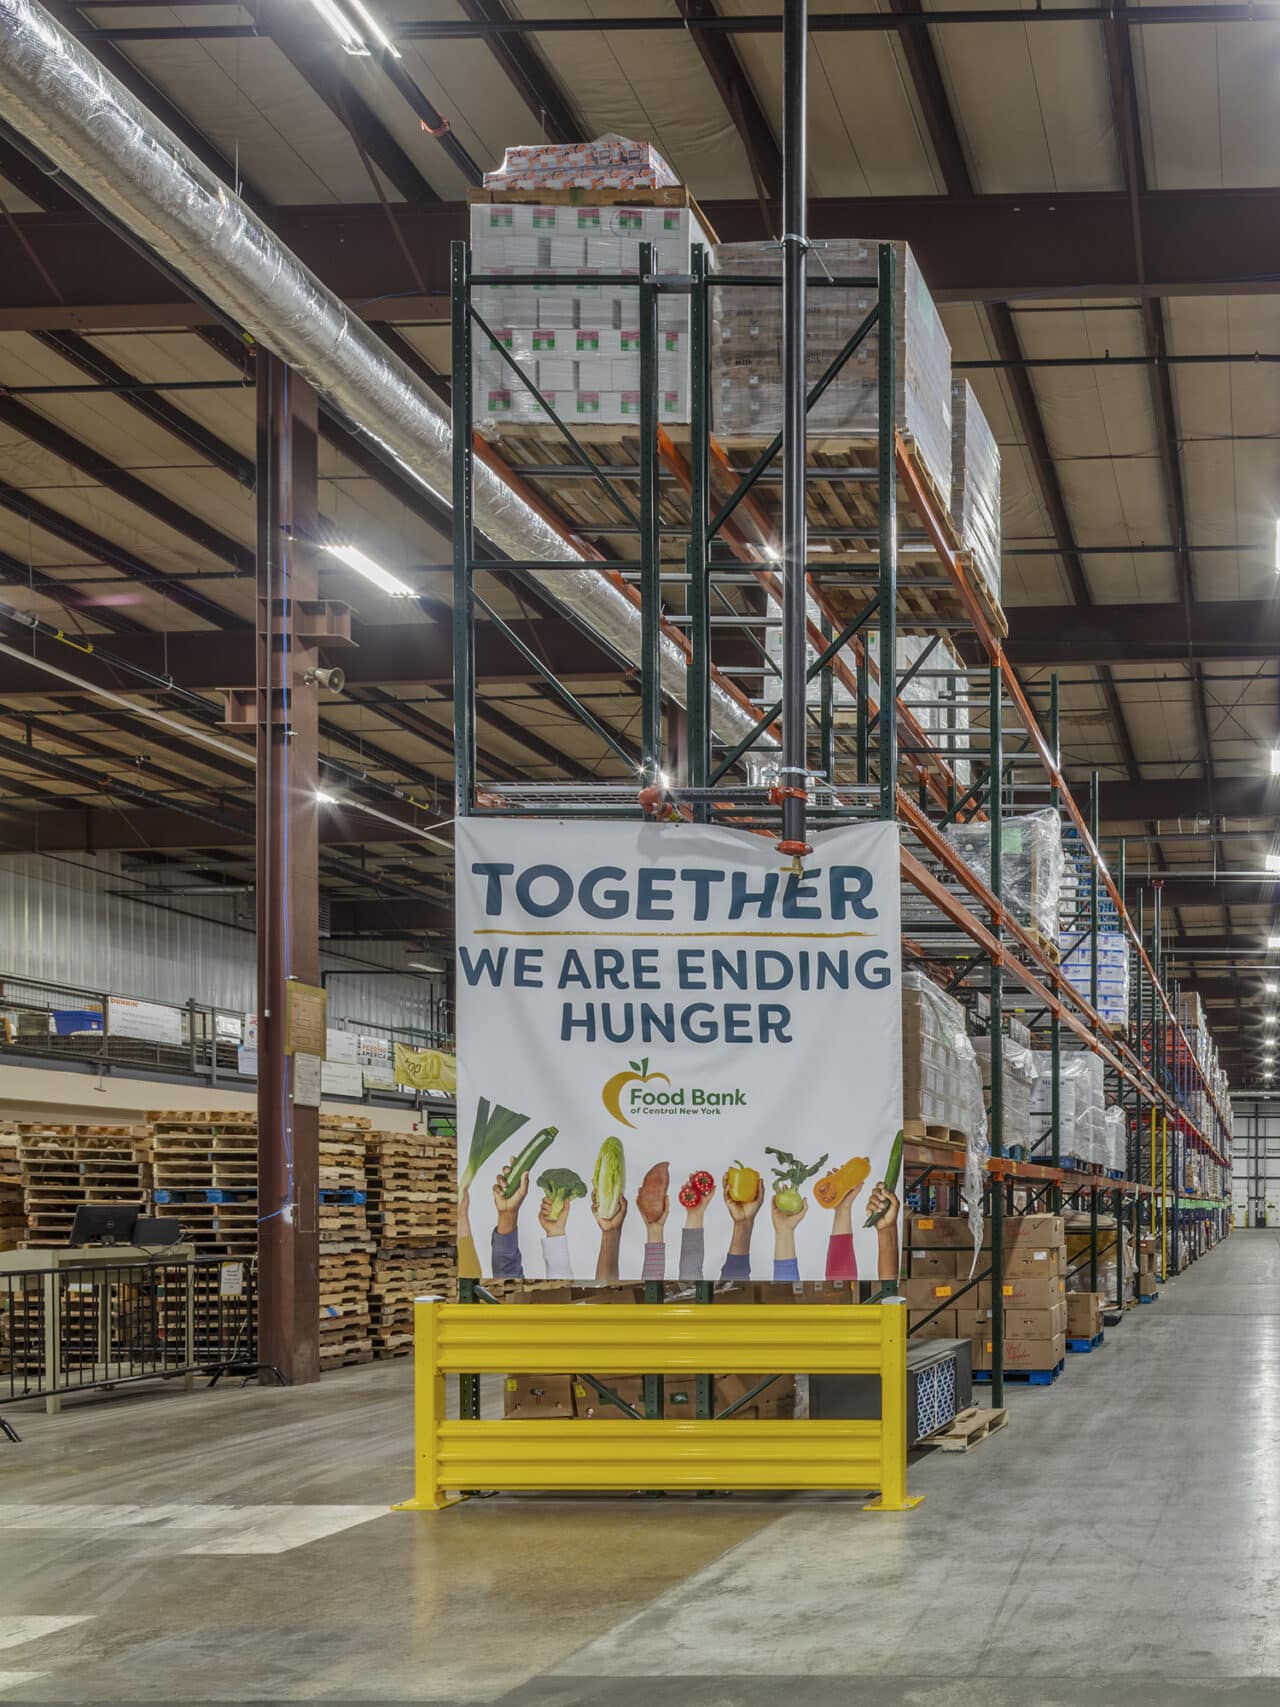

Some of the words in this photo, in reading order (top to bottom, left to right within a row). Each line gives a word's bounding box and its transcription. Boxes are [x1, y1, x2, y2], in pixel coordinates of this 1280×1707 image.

[472, 863, 879, 922] TOGETHER
[459, 945, 545, 988] WE
[558, 948, 660, 990] ARE
[677, 948, 893, 992] ENDING
[560, 1002, 793, 1044] HUNGER
[361, 1051, 387, 1059] AMERICA
[630, 1088, 685, 1105] Food
[691, 1088, 747, 1106] Bank
[643, 1107, 677, 1115] Central
[679, 1107, 699, 1115] New
[701, 1107, 721, 1115] York
